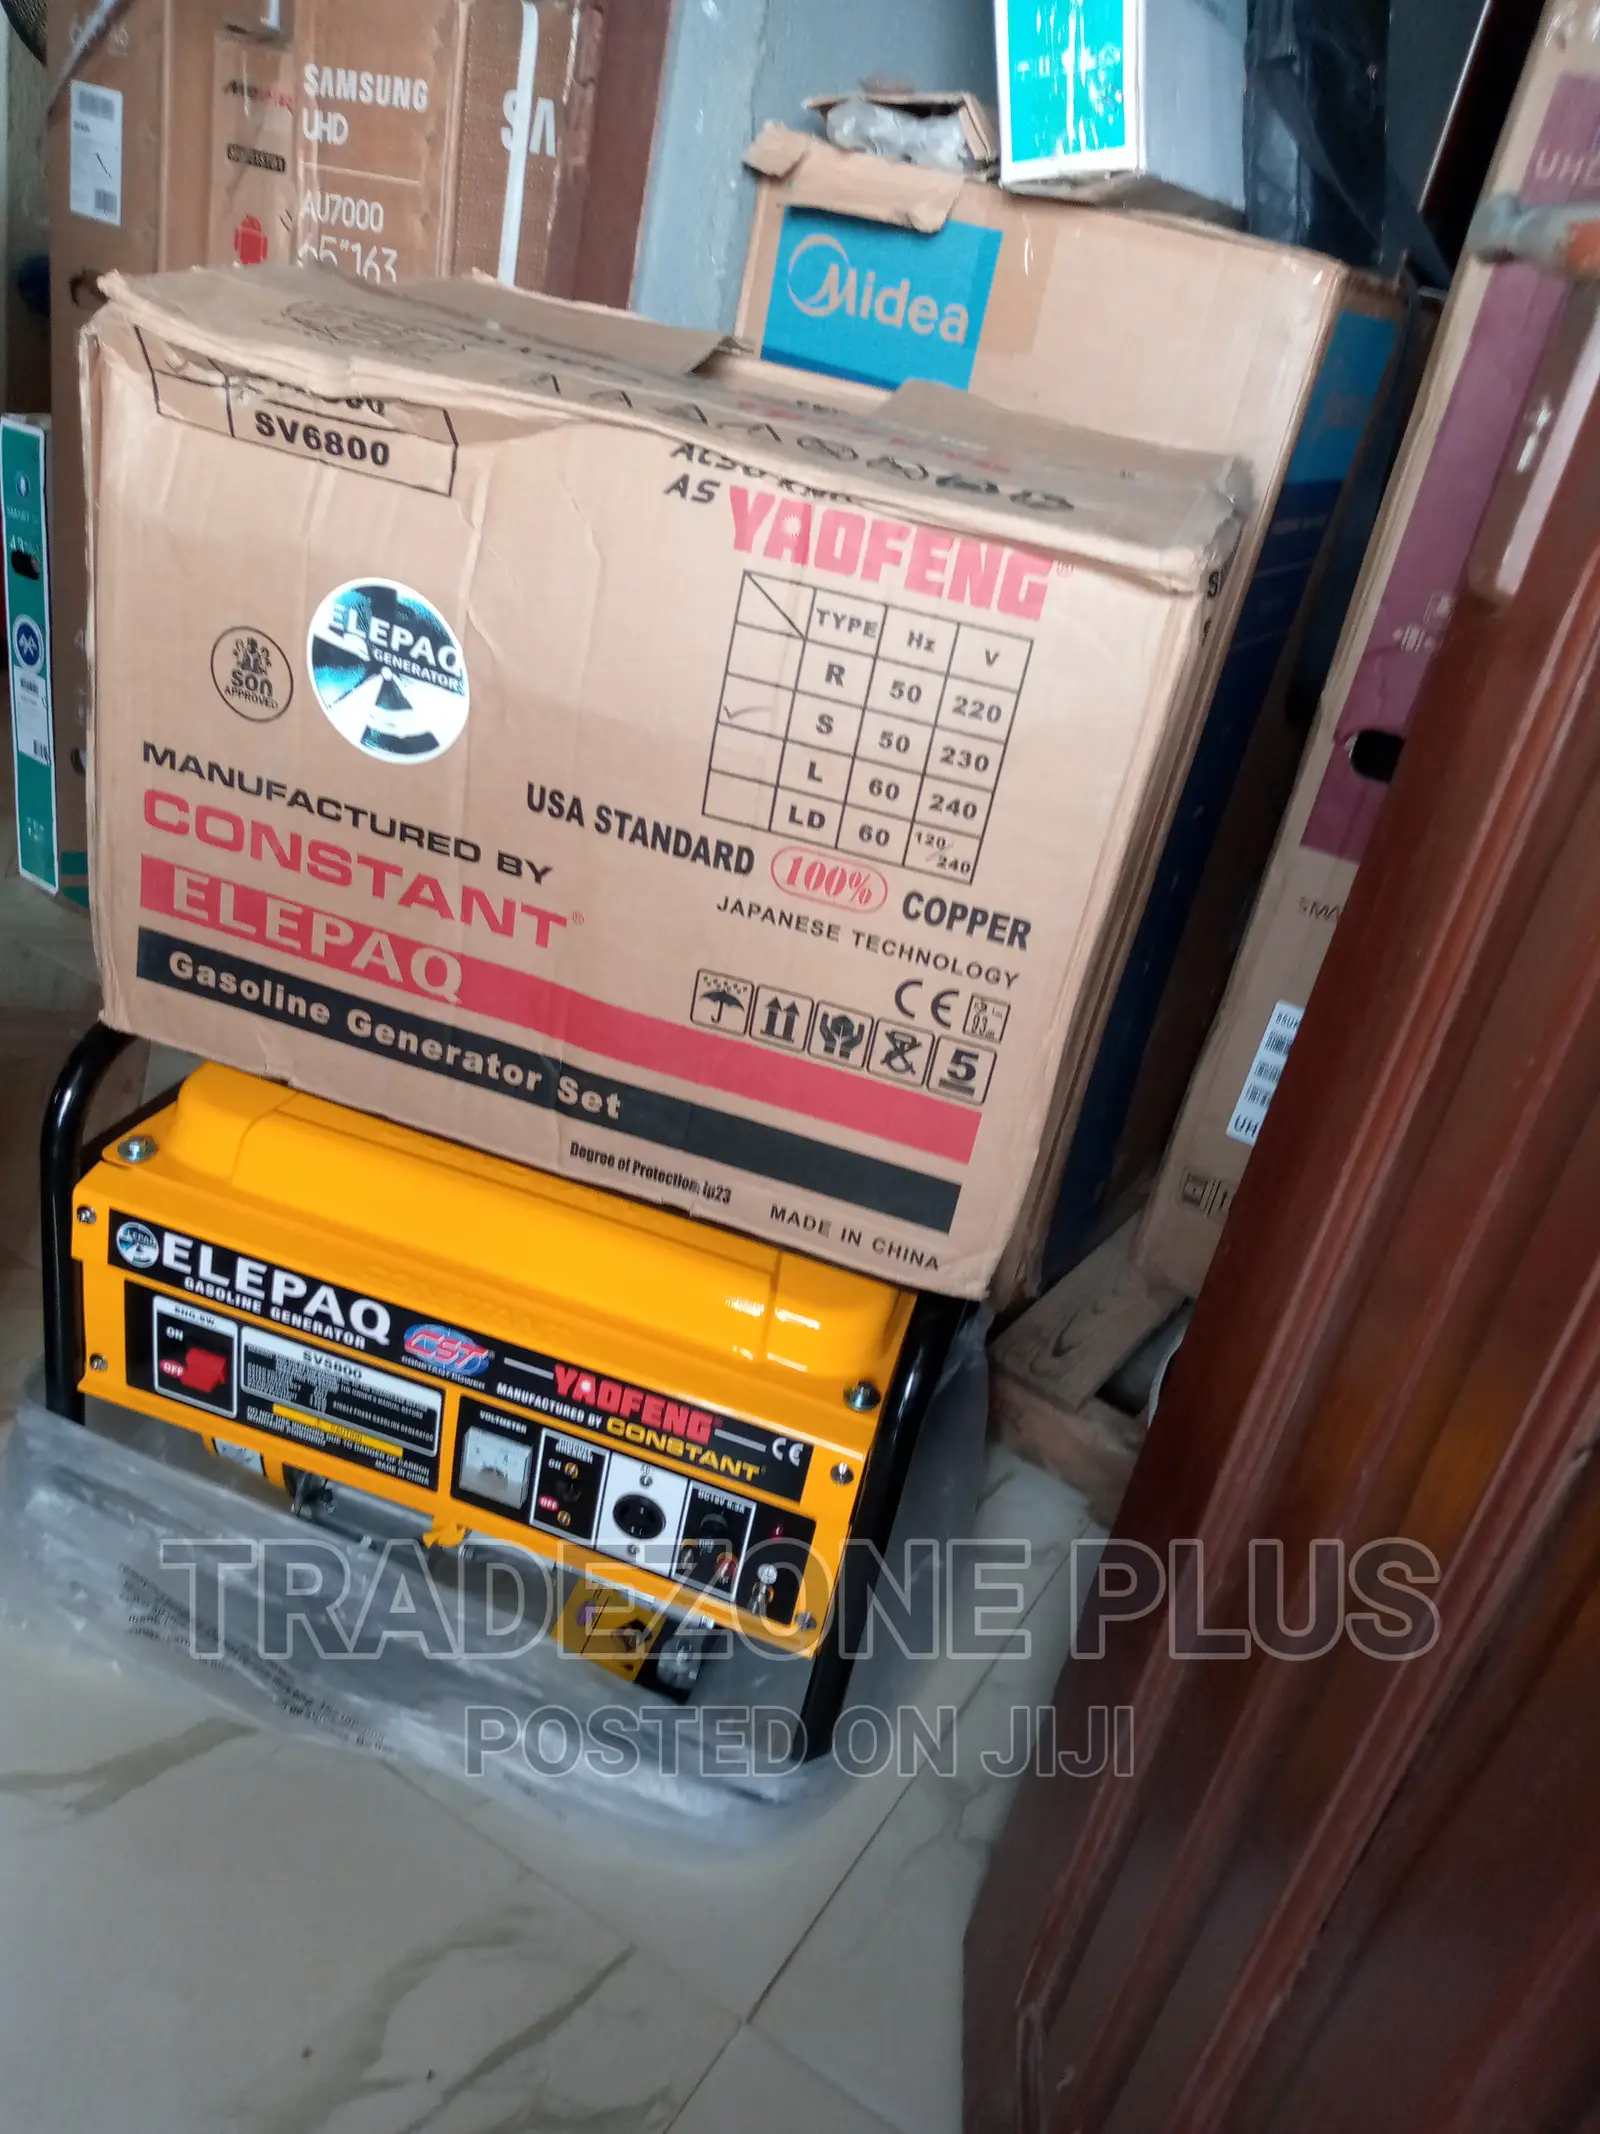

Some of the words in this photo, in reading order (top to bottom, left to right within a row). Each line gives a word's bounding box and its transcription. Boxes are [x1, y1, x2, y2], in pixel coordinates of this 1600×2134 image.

[303, 62, 429, 113] SAMSUNG
[302, 108, 350, 147] UHD
[299, 188, 384, 234] AU7000
[787, 234, 970, 344] Midea
[254, 409, 390, 467] SV6800
[663, 472, 721, 504] AS
[728, 486, 1055, 621] YAOFENG
[815, 608, 878, 640] TYPE
[906, 630, 936, 654] Hz
[984, 649, 999, 667] V
[224, 684, 280, 711] APPROVED
[372, 648, 465, 696] GENERATORS
[825, 663, 846, 688] R
[889, 682, 923, 706] 50
[951, 696, 1003, 725] 220
[815, 714, 835, 736] S
[878, 731, 911, 754] 50
[940, 747, 990, 774] 230
[142, 740, 481, 863] MANUFACTURED
[497, 849, 553, 886] BY
[807, 761, 824, 782] L
[868, 779, 901, 802] 60
[928, 793, 978, 822] 240
[787, 804, 827, 831] LD
[858, 825, 891, 849] 60
[142, 788, 569, 950] CONSTANT
[526, 781, 585, 828] USA
[594, 807, 756, 877] STANDARD
[784, 854, 874, 909] 100%
[902, 889, 1032, 952] COPPER
[171, 865, 464, 1006] ELEPAQ
[716, 895, 840, 943] JAPANESE
[852, 927, 1021, 991] TECHNOLOGY
[894, 978, 960, 1030] CE
[168, 950, 332, 1026] Gasoline
[346, 1007, 544, 1092] Generator
[557, 1074, 621, 1120] Set
[570, 1140, 615, 1171] Degree
[616, 1155, 632, 1174] of
[770, 1203, 832, 1236] MADE
[840, 1226, 863, 1247] IN
[872, 1236, 940, 1273] CHINA
[162, 1231, 391, 1347] ELEPAQ
[184, 1275, 262, 1315] GASOLINE
[269, 1307, 366, 1351] GENERATOR
[165, 1325, 184, 1342] ON
[403, 1329, 489, 1369] CST
[162, 1361, 185, 1377] OFF
[479, 1410, 528, 1436] VOLTMETER
[496, 1381, 586, 1426] MANUFACTURED
[587, 1412, 604, 1430] BY
[605, 1413, 762, 1482] CONSTANT
[554, 1363, 716, 1446] YAOFENG
[771, 1435, 805, 1467] CE
